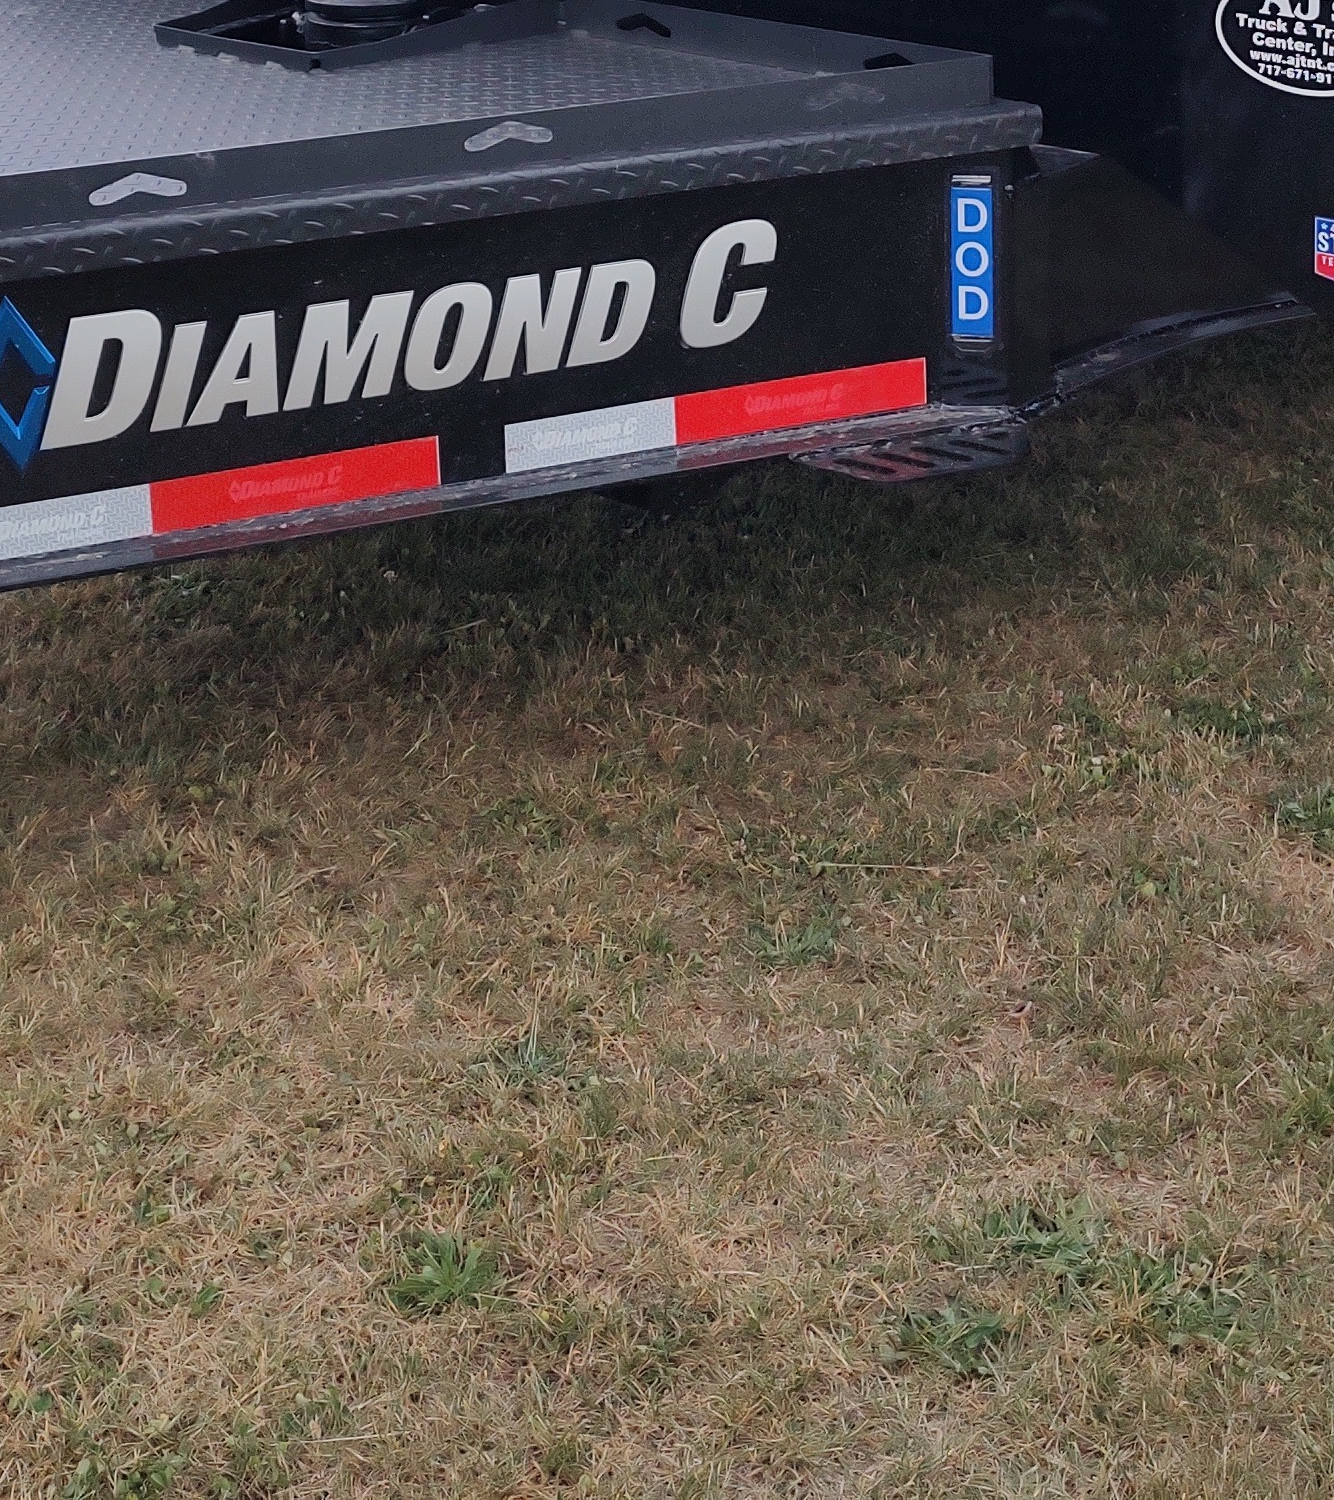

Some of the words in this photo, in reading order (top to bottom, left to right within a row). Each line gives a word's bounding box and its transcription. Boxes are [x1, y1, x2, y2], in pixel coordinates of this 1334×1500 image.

[1235, 12, 1289, 34] Truck
[1293, 21, 1308, 37] &
[1252, 31, 1317, 57] Center,
[955, 197, 989, 321] DOD
[39, 258, 657, 451] DIAMOND
[680, 218, 778, 350] C
